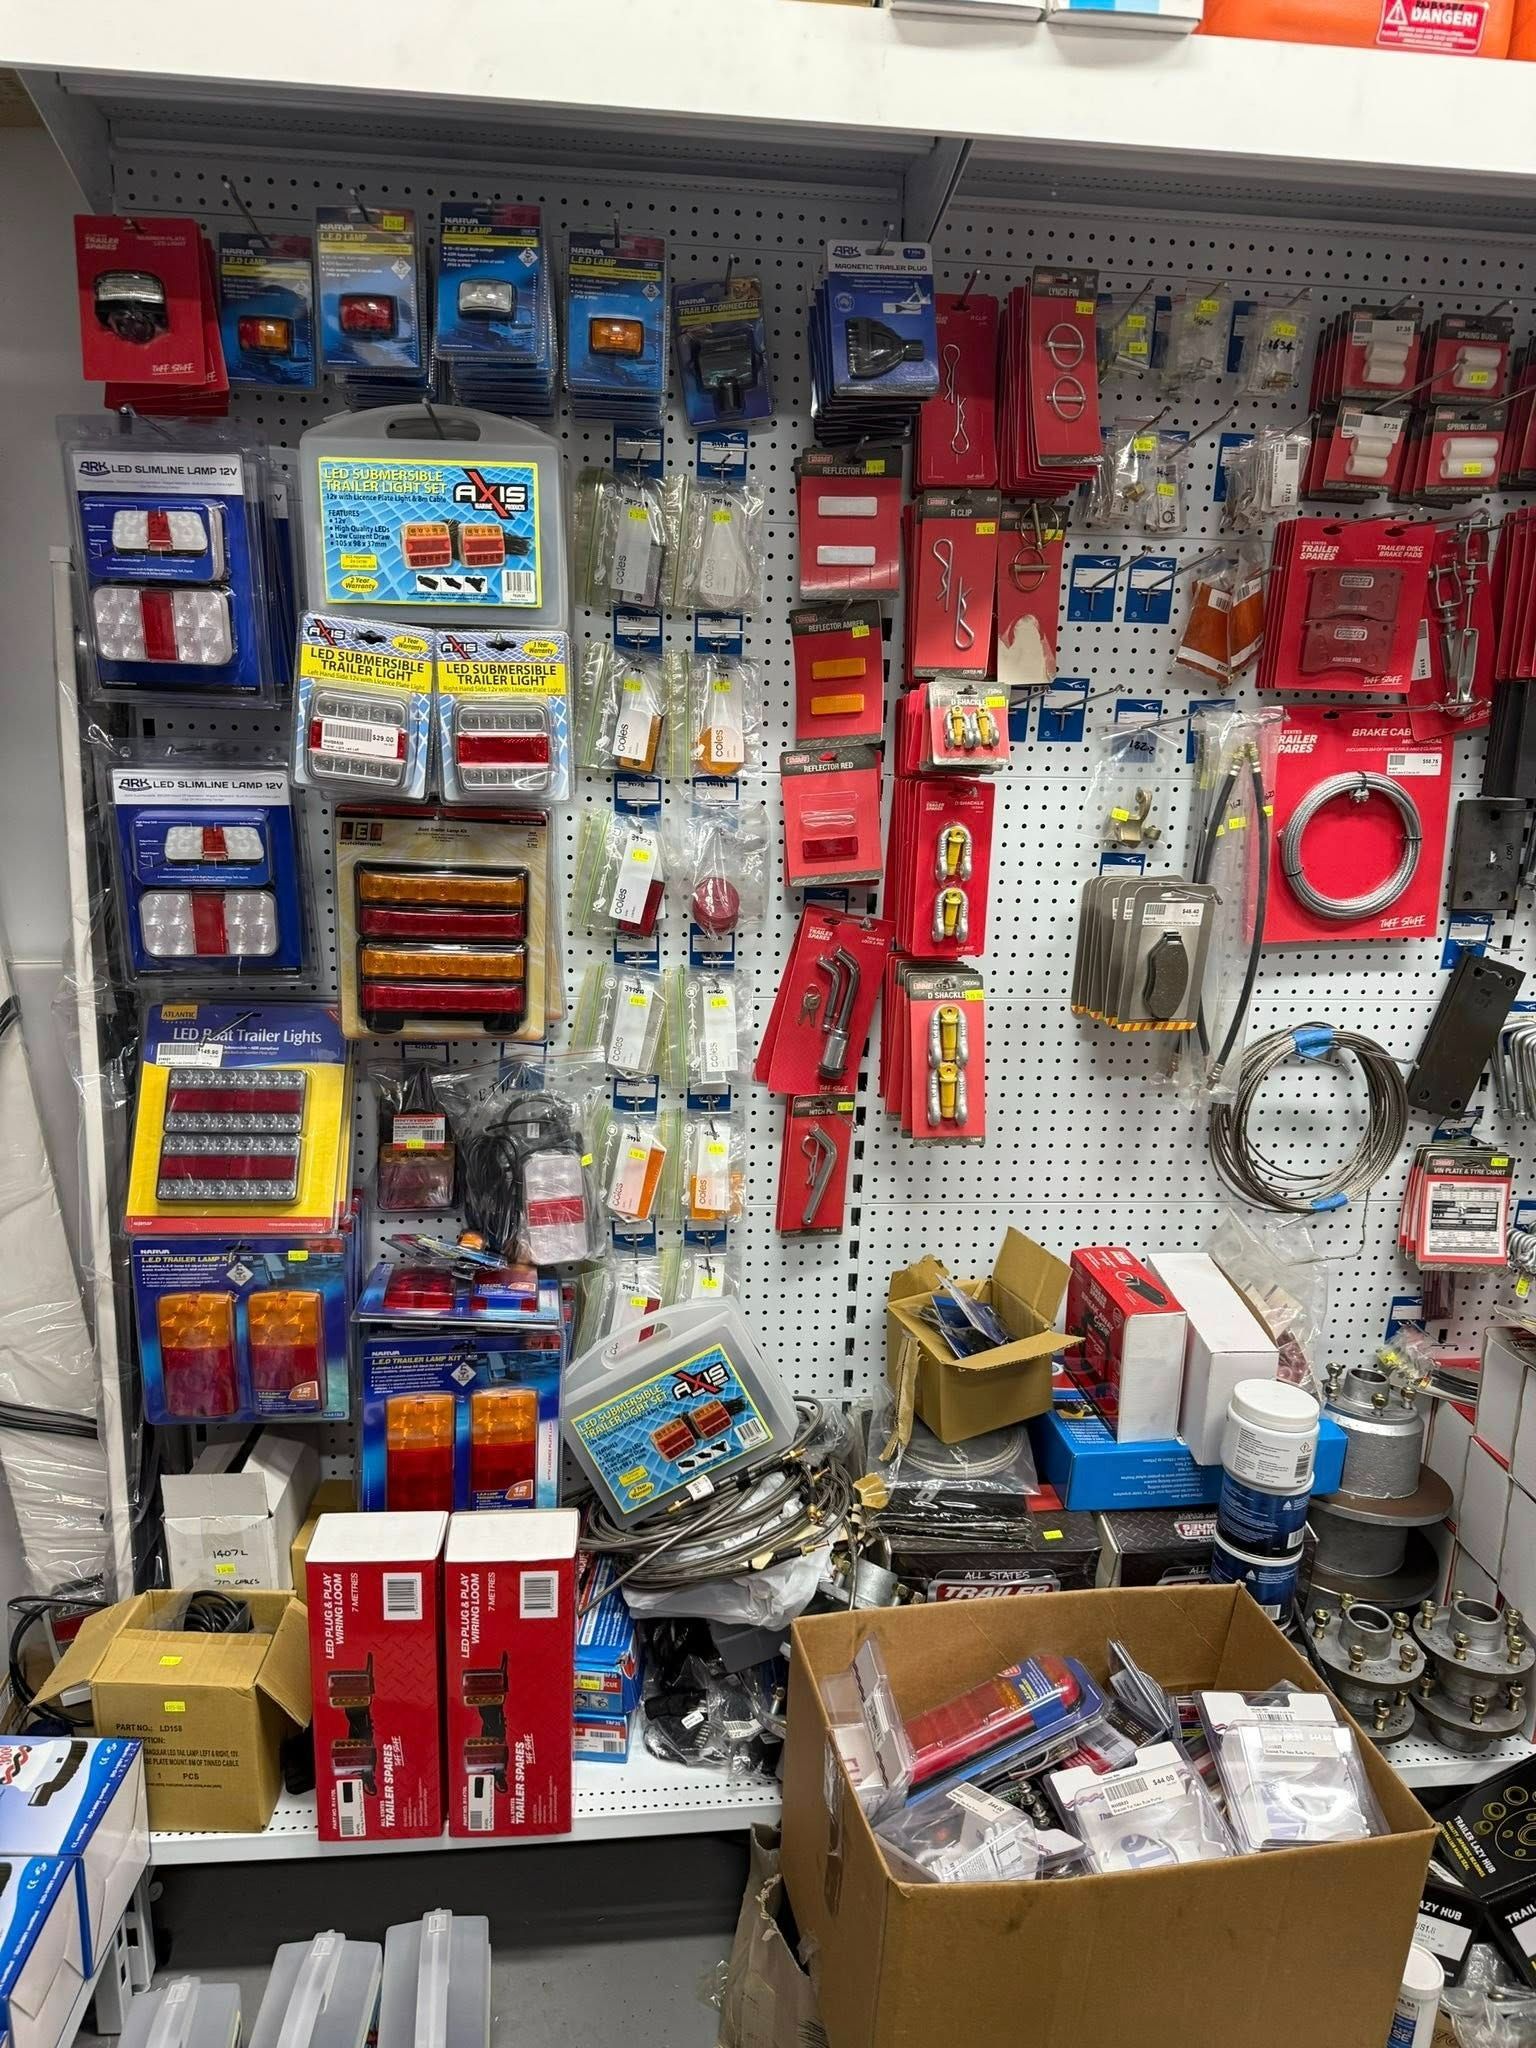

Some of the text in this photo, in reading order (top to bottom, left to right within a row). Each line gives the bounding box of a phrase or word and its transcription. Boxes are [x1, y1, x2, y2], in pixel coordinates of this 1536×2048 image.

[1411, 7, 1478, 27] DANGER!
[320, 223, 353, 231] NARVA
[444, 217, 479, 225] NARVA
[470, 227, 492, 235] LAMP
[344, 233, 367, 242] LAMP
[571, 247, 604, 256] NARVA
[833, 245, 859, 257] ARK
[593, 257, 617, 267] LAMP
[835, 263, 872, 271] MAGNETIC
[1048, 287, 1080, 297] LYNCH PIN
[679, 300, 758, 315] TRAILER CONNECTOR
[1457, 331, 1498, 341] SPRING BUSH
[1446, 422, 1487, 431] SPRING BUSH
[80, 461, 237, 476] ARK LED SLIMLINE LAMP 12V
[822, 467, 860, 475] REFLECTOR
[325, 468, 444, 482] LED SUBMERSIBLE
[326, 481, 448, 494] TRAILER LIGHT SET
[395, 495, 411, 503] Light
[455, 471, 525, 518] AXIS
[957, 509, 972, 517] CLIP
[334, 526, 349, 534] High
[350, 526, 373, 534] Quality
[1301, 545, 1340, 553] TRAILER
[1300, 552, 1337, 561] SPARES
[616, 554, 627, 585] coles
[345, 582, 375, 591] Warranty
[808, 623, 847, 632] REFLECTOR
[406, 636, 419, 644] Year
[398, 641, 423, 653] Warranty
[529, 647, 553, 655] Warranty
[310, 647, 424, 673] LED SUBMERSIBLE
[321, 659, 413, 682] TRAILER LIGHT
[446, 663, 556, 676] LED SUBMERSIBLE
[457, 674, 546, 686] TRAILER LIGHT
[957, 698, 986, 706] SHACKLE
[616, 723, 629, 752] coles
[1352, 728, 1412, 737] BRAKE CAB
[372, 734, 395, 744] $29.00
[715, 728, 724, 758] coles
[1277, 735, 1318, 745] RAILER
[1275, 744, 1315, 754] PARES
[803, 761, 854, 773] REFLECTOR RED
[119, 778, 283, 790] ARK LED SLIMLINE LAMP 12V
[615, 887, 628, 915] coles
[1379, 915, 1426, 928] TUFF STUFF
[807, 933, 832, 942] SPARES
[808, 928, 834, 938] TRAILER
[934, 990, 966, 1000] SHACKLE
[163, 1010, 196, 1018] ATLANTIC
[173, 1027, 199, 1041] LED
[236, 1028, 279, 1043] Trailer
[283, 1030, 323, 1047] Lights
[612, 1035, 625, 1062] coles
[809, 1108, 822, 1116] HITCH
[1486, 1168, 1506, 1176] CHART
[613, 1182, 624, 1207] coles
[699, 1179, 707, 1205] coles
[198, 1255, 220, 1263] LAMP
[392, 1354, 463, 1364] TRAILER LAMP KIT
[579, 1384, 662, 1432] LED SUBMERSIBLE
[584, 1401, 650, 1439] TRAILER LIGHT
[964, 1570, 1031, 1580] ALL STATES
[350, 1572, 359, 1607] METRES
[488, 1572, 496, 1606] METRES
[945, 1585, 1053, 1600] TRAILER
[333, 1573, 345, 1646] WIRING LOOM
[470, 1572, 480, 1644] WIRING LOOM
[322, 1572, 335, 1660] LED PLUG PLAY
[460, 1572, 470, 1659] LED PLUG PLAY
[116, 1723, 136, 1732] PART
[382, 1744, 396, 1828] TRAILER SPARES
[514, 1741, 525, 1825] TRAILER SPARES
[1454, 1816, 1497, 1874] TRAILER LAZY HUB
[1440, 1907, 1463, 1921] HUB
[1504, 1903, 1536, 1924] TRAIL
